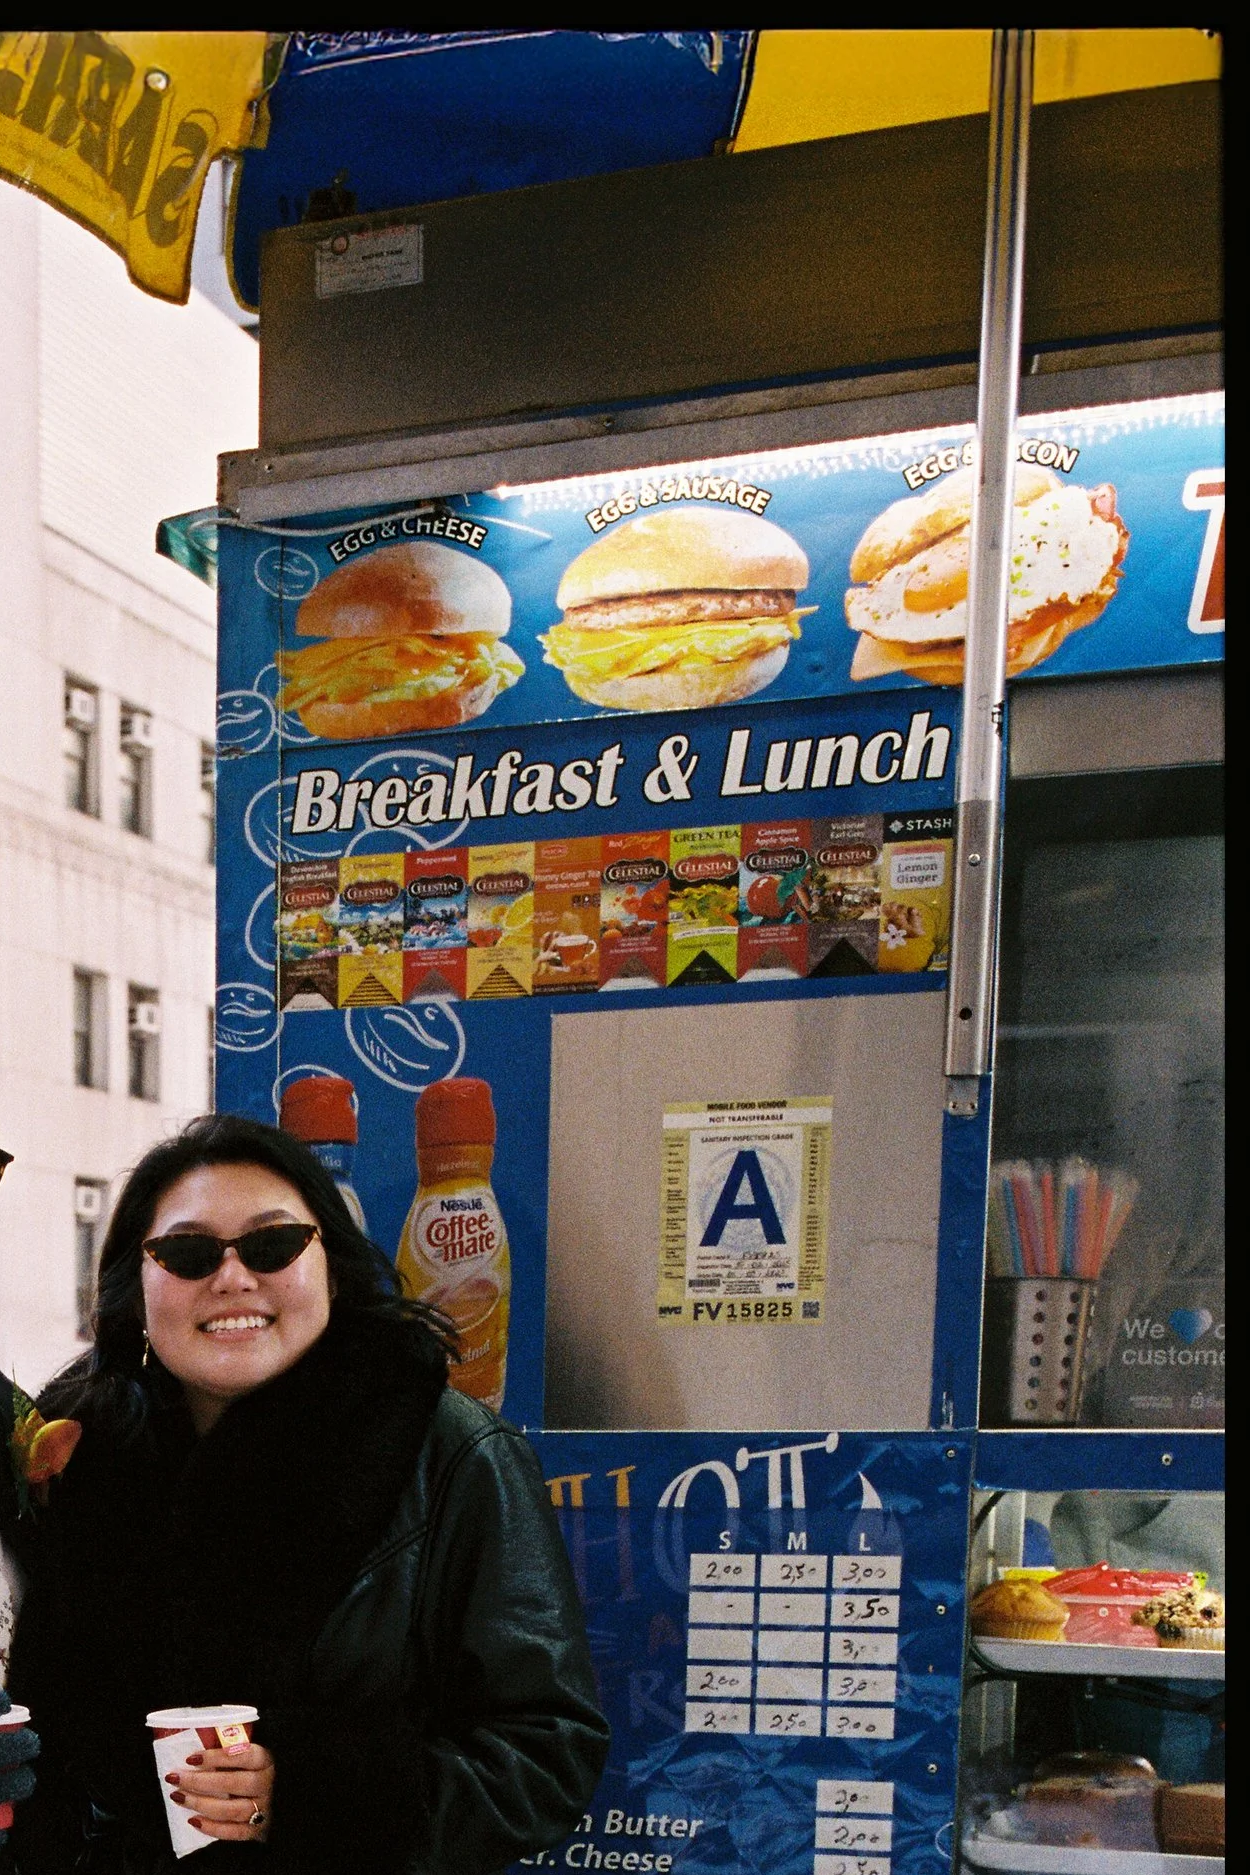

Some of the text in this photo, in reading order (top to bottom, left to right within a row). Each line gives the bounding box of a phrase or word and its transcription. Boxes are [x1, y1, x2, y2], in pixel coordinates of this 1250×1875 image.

[903, 447, 958, 490] EGG
[1017, 437, 1080, 473] CON
[586, 476, 772, 533] EGG & SAUSAGE
[329, 515, 487, 562] EGG & CHEESE
[290, 710, 951, 836] Breakfast & Lunch
[906, 817, 952, 831] STASH
[674, 829, 739, 843] GREEN TEA
[609, 840, 623, 848] Red
[749, 855, 801, 868] CELESTIAL
[819, 850, 873, 864] CELESTIAL
[609, 866, 660, 880] CELESTIAL
[678, 861, 732, 874] CELESTIAL
[897, 862, 938, 872] Lemon
[476, 879, 524, 891] CELESTIAL
[897, 872, 938, 884] Ginger
[347, 888, 394, 900] CELESTIAL
[410, 882, 458, 894] CELESTIAL
[285, 892, 330, 904] CELESTIAL
[707, 1100, 787, 1111] MOBILE FOOD VENDOR
[699, 1150, 787, 1246] A
[443, 1230, 495, 1263] mate
[658, 1305, 682, 1315] NYC
[1124, 1317, 1165, 1340] We
[719, 1531, 732, 1550] S
[787, 1531, 808, 1551] M
[859, 1532, 871, 1552] L
[843, 1597, 890, 1624] 3,50
[604, 1808, 704, 1838] Butter
[565, 1842, 673, 1873] Cheese
